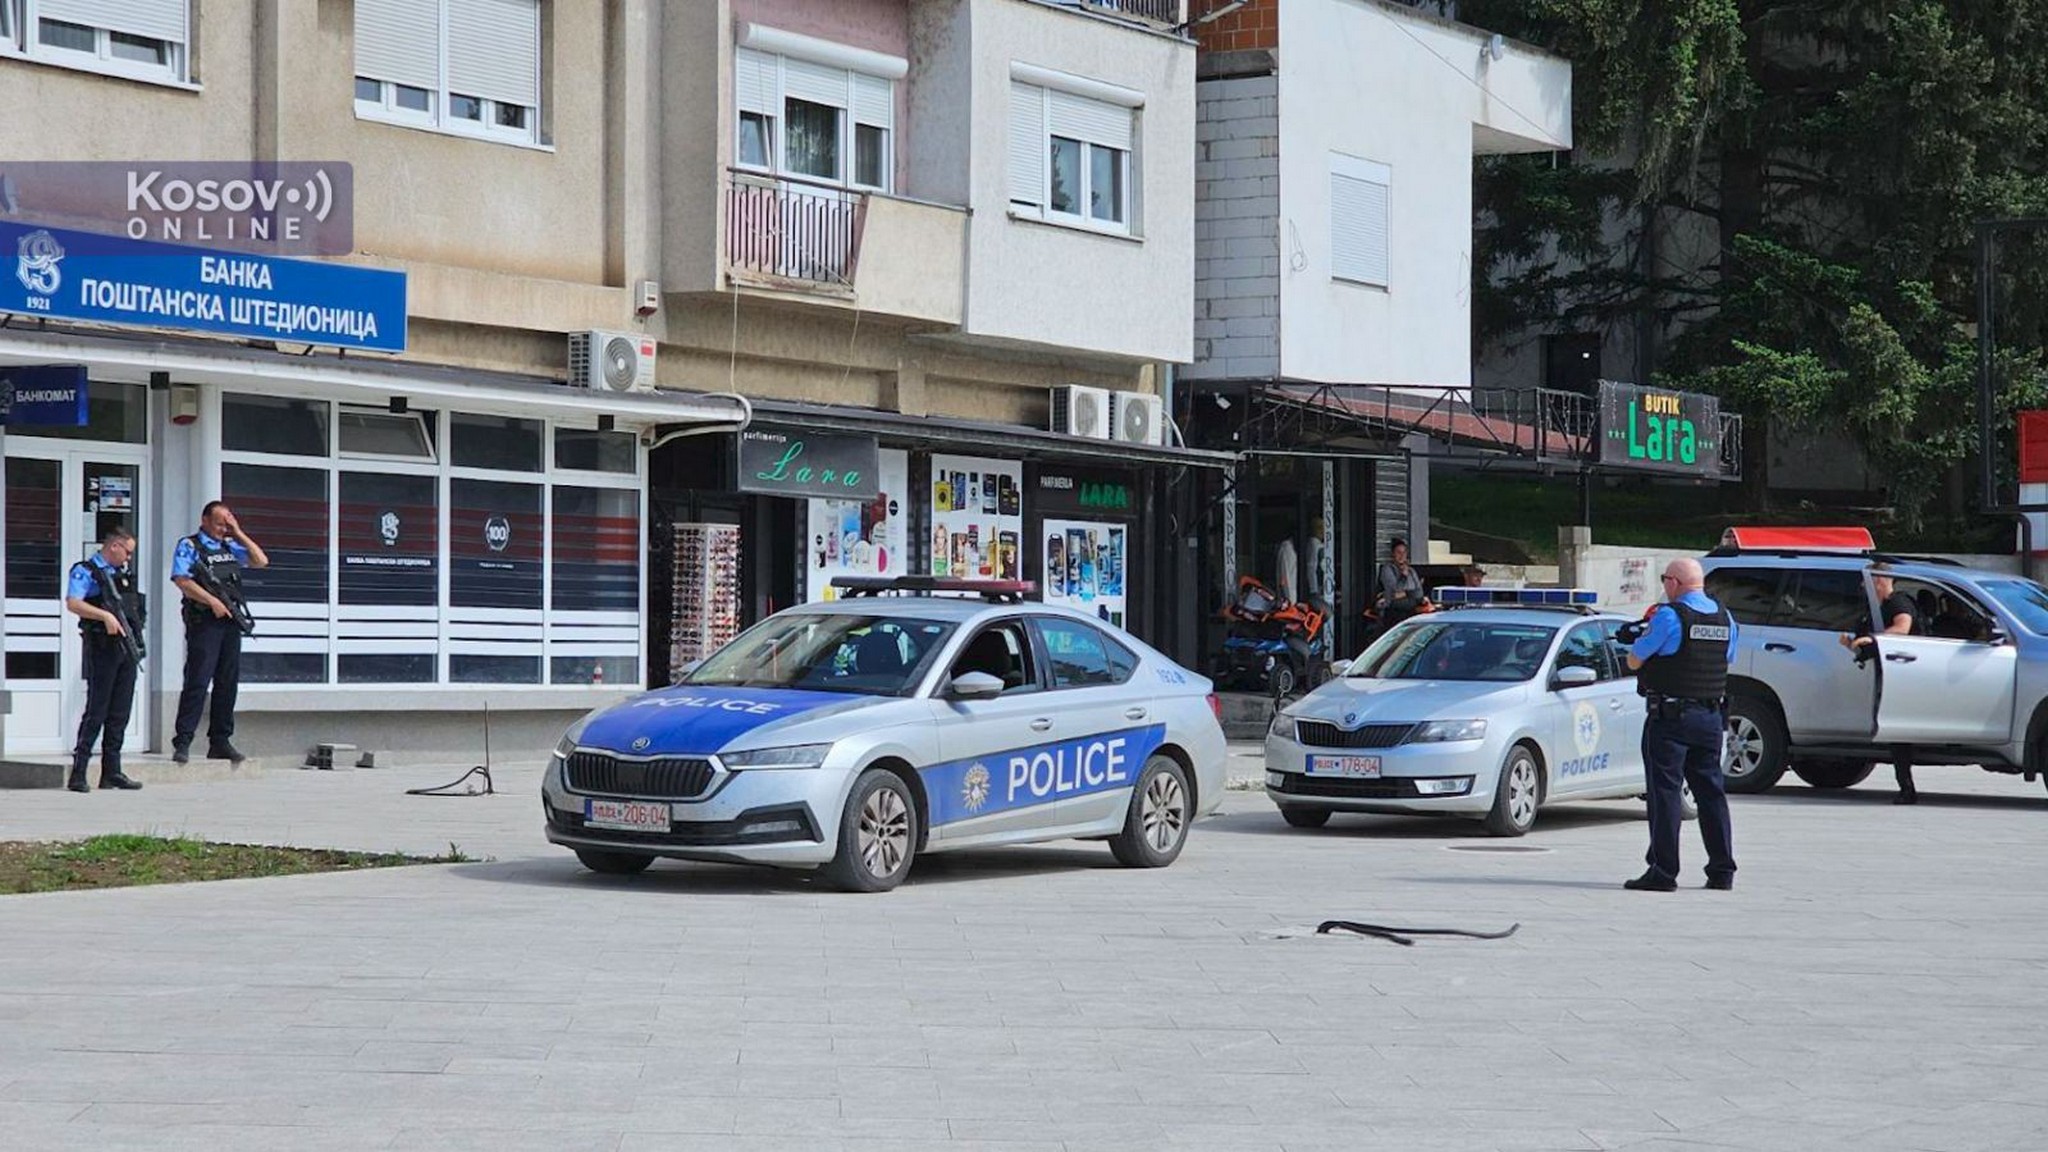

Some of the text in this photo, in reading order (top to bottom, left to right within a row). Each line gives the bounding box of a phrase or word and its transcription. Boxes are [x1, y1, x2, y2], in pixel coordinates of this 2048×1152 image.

[200, 257, 273, 290] БАНКА
[26, 297, 51, 311] 1921
[81, 279, 378, 341] ПОШТАНСКА ШТЕДИОНИЦА
[15, 389, 77, 403] БАНКОМАТ
[1644, 394, 1680, 415] BUTIK
[756, 441, 862, 488] Lara
[1080, 482, 1128, 509] LARA
[488, 525, 507, 541] 100
[1692, 626, 1728, 638] POLICE
[632, 696, 783, 715] POLICE
[1008, 737, 1126, 802] POLICE
[1561, 752, 1610, 778] POLICE
